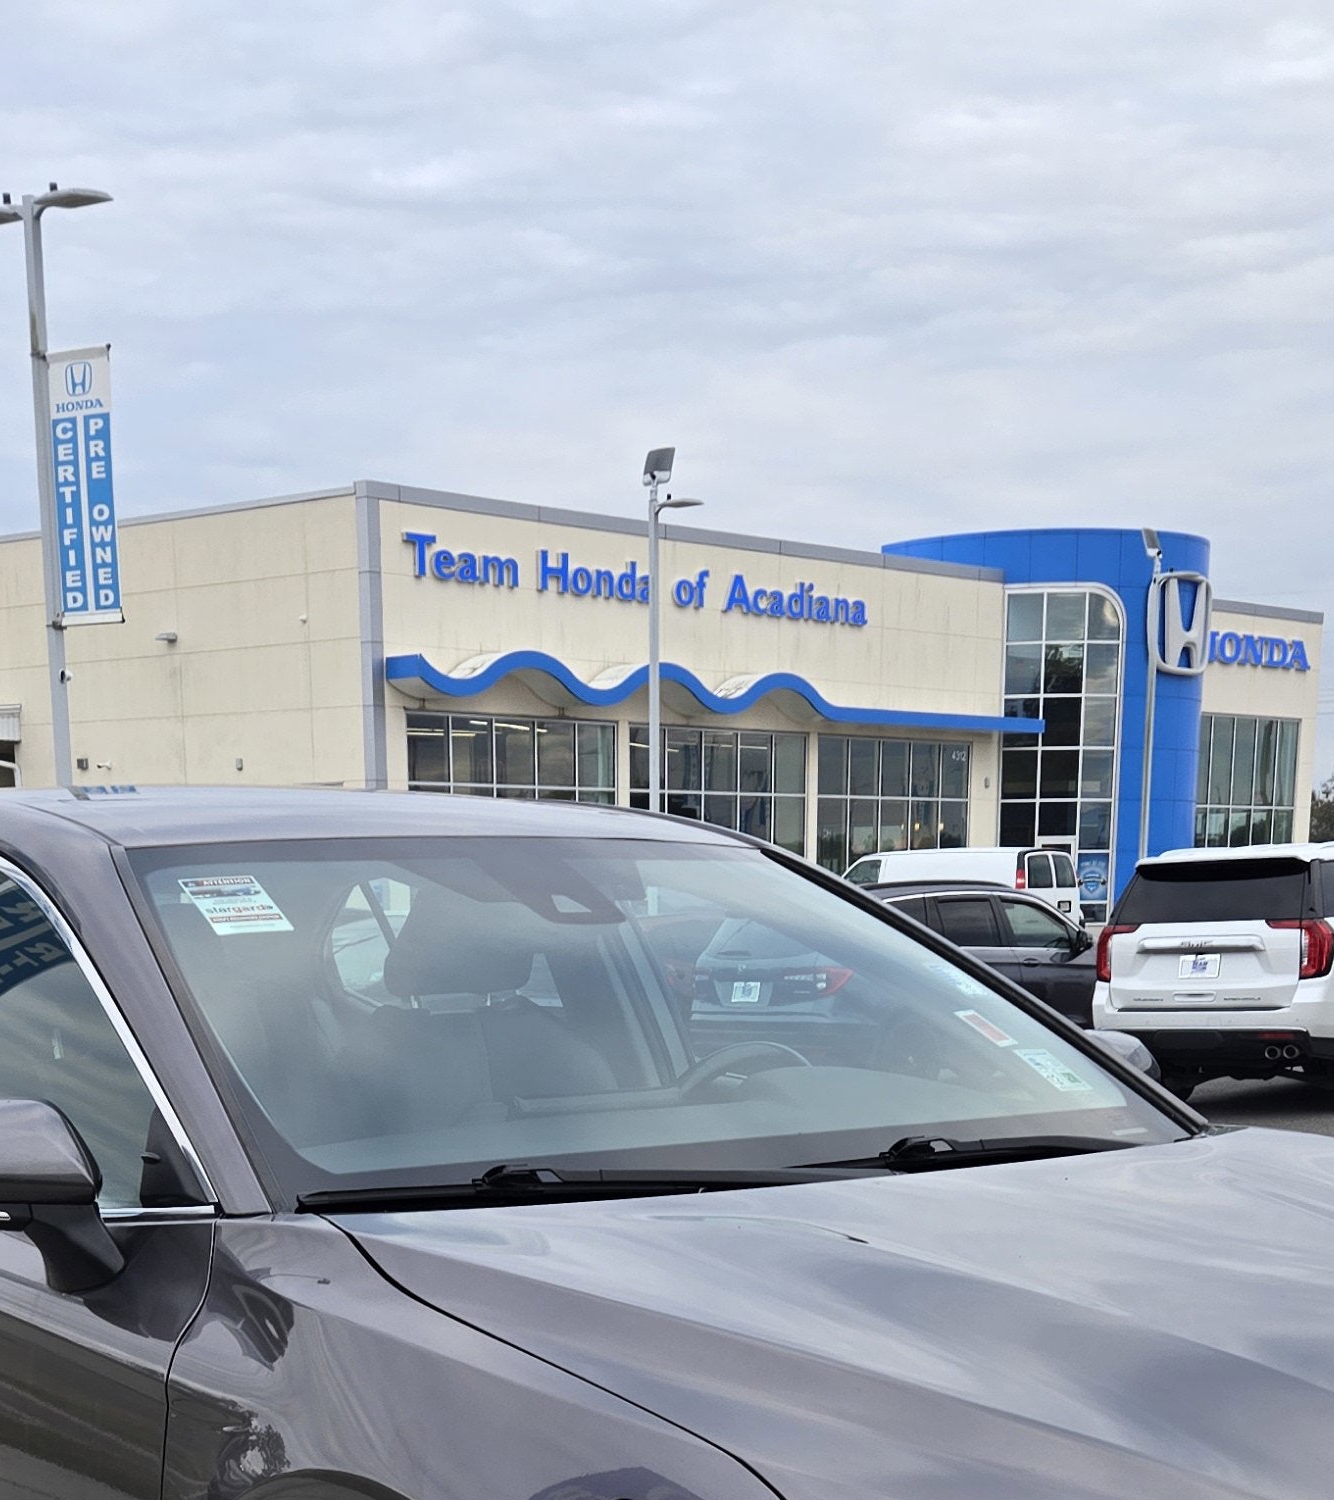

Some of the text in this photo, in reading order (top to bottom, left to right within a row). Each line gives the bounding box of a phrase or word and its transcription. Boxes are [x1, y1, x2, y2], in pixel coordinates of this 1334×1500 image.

[55, 399, 104, 414] HONDA
[55, 421, 84, 608] CERTIFIED
[88, 417, 114, 607] PRE OWNED
[403, 531, 868, 627] Team Honda of Acadiana
